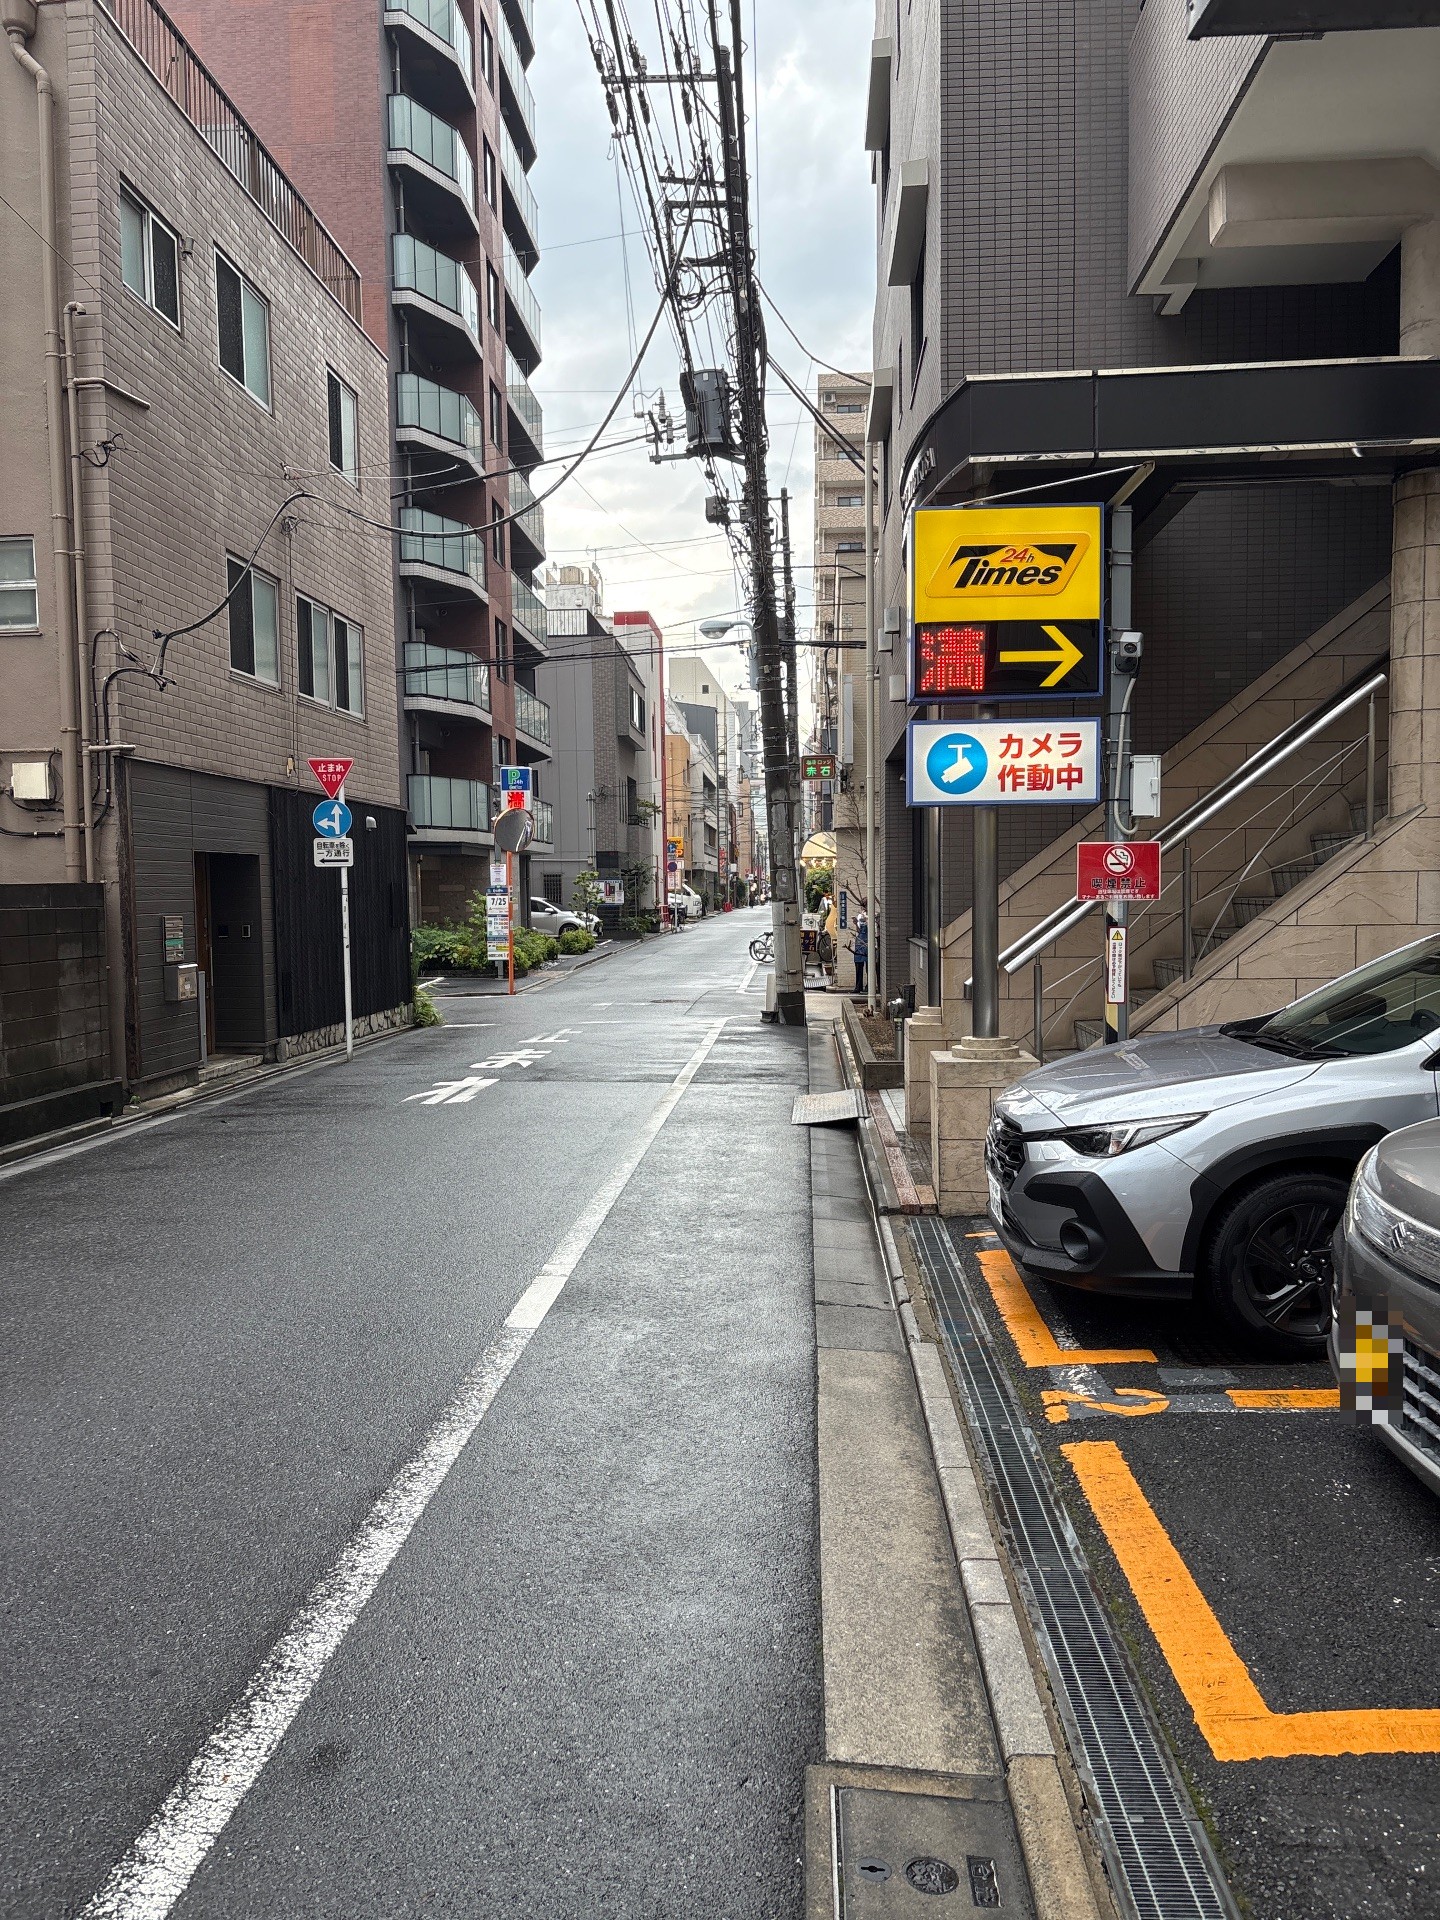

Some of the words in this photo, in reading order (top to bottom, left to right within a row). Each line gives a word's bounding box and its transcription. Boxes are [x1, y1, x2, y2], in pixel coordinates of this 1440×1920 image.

[1000, 547, 1035, 563] 24h
[953, 555, 1063, 589] Times
[921, 627, 984, 691] 満
[998, 732, 1083, 759] カメラ
[317, 763, 345, 773] 止まれ
[806, 766, 831, 777] 赤石
[322, 774, 342, 782] STOP
[997, 762, 1083, 793] 作動中
[316, 841, 350, 850] 自転車を除く
[316, 849, 350, 858] 一方通行
[1091, 877, 1146, 889] 喫煙禁止
[490, 897, 507, 906] 7/25
